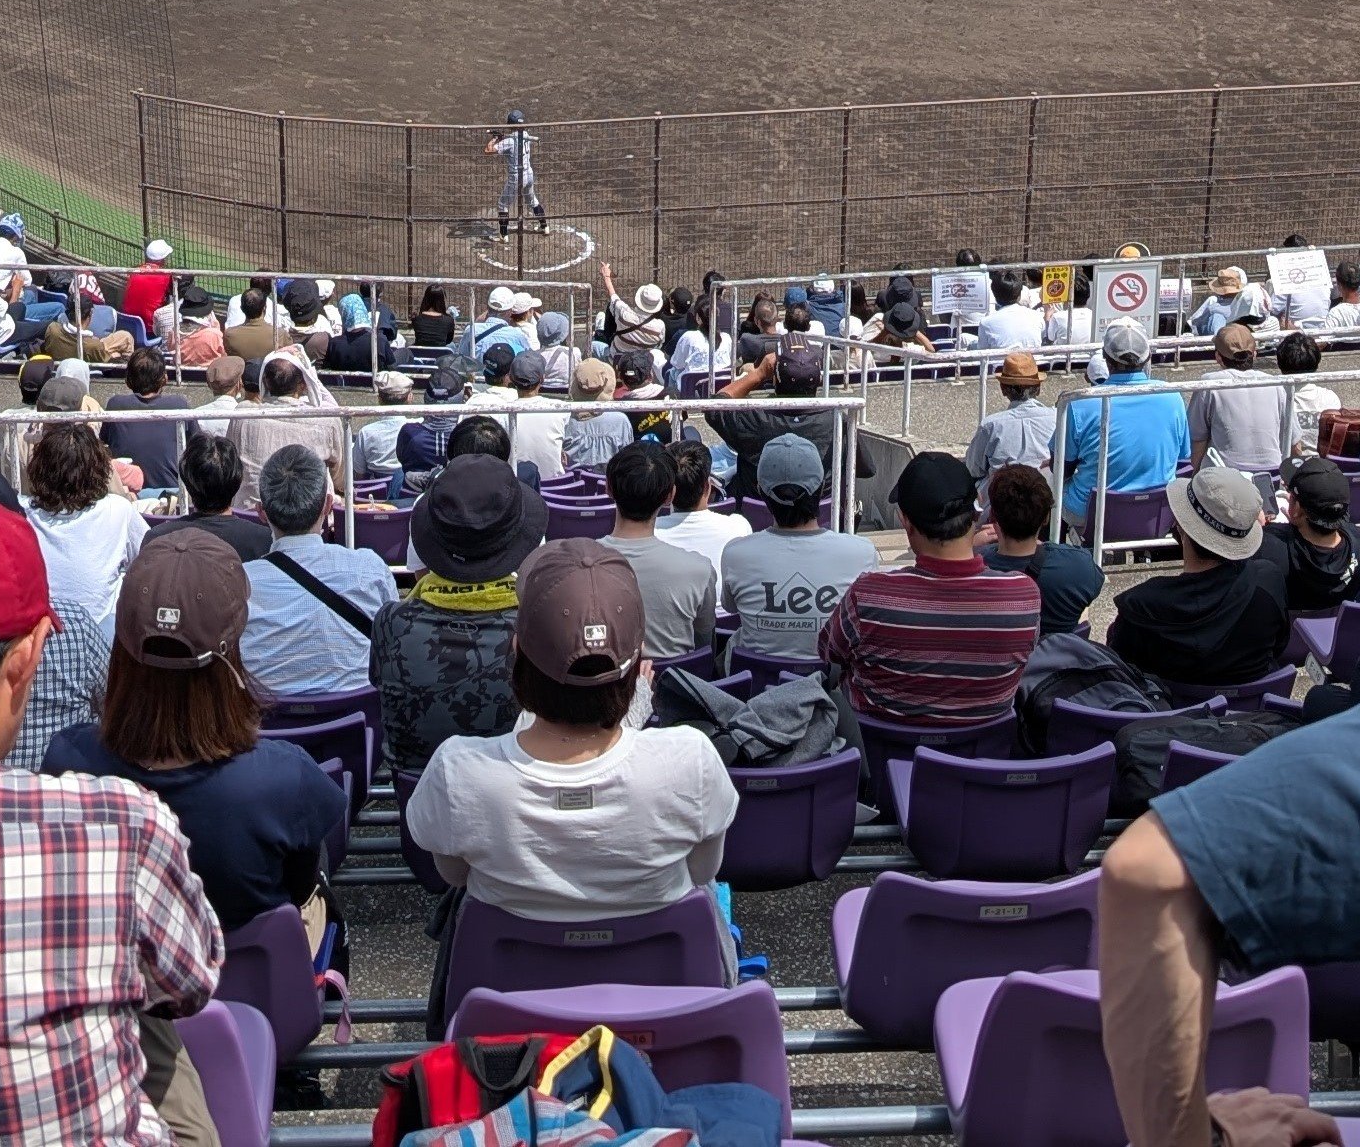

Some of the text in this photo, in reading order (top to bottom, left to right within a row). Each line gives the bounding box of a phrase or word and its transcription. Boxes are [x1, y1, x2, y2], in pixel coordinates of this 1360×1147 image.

[761, 581, 839, 614] Lee
[760, 619, 814, 629] TRADE MARK
[984, 907, 1024, 916] F-21-17
[568, 932, 609, 941] F-21-16
